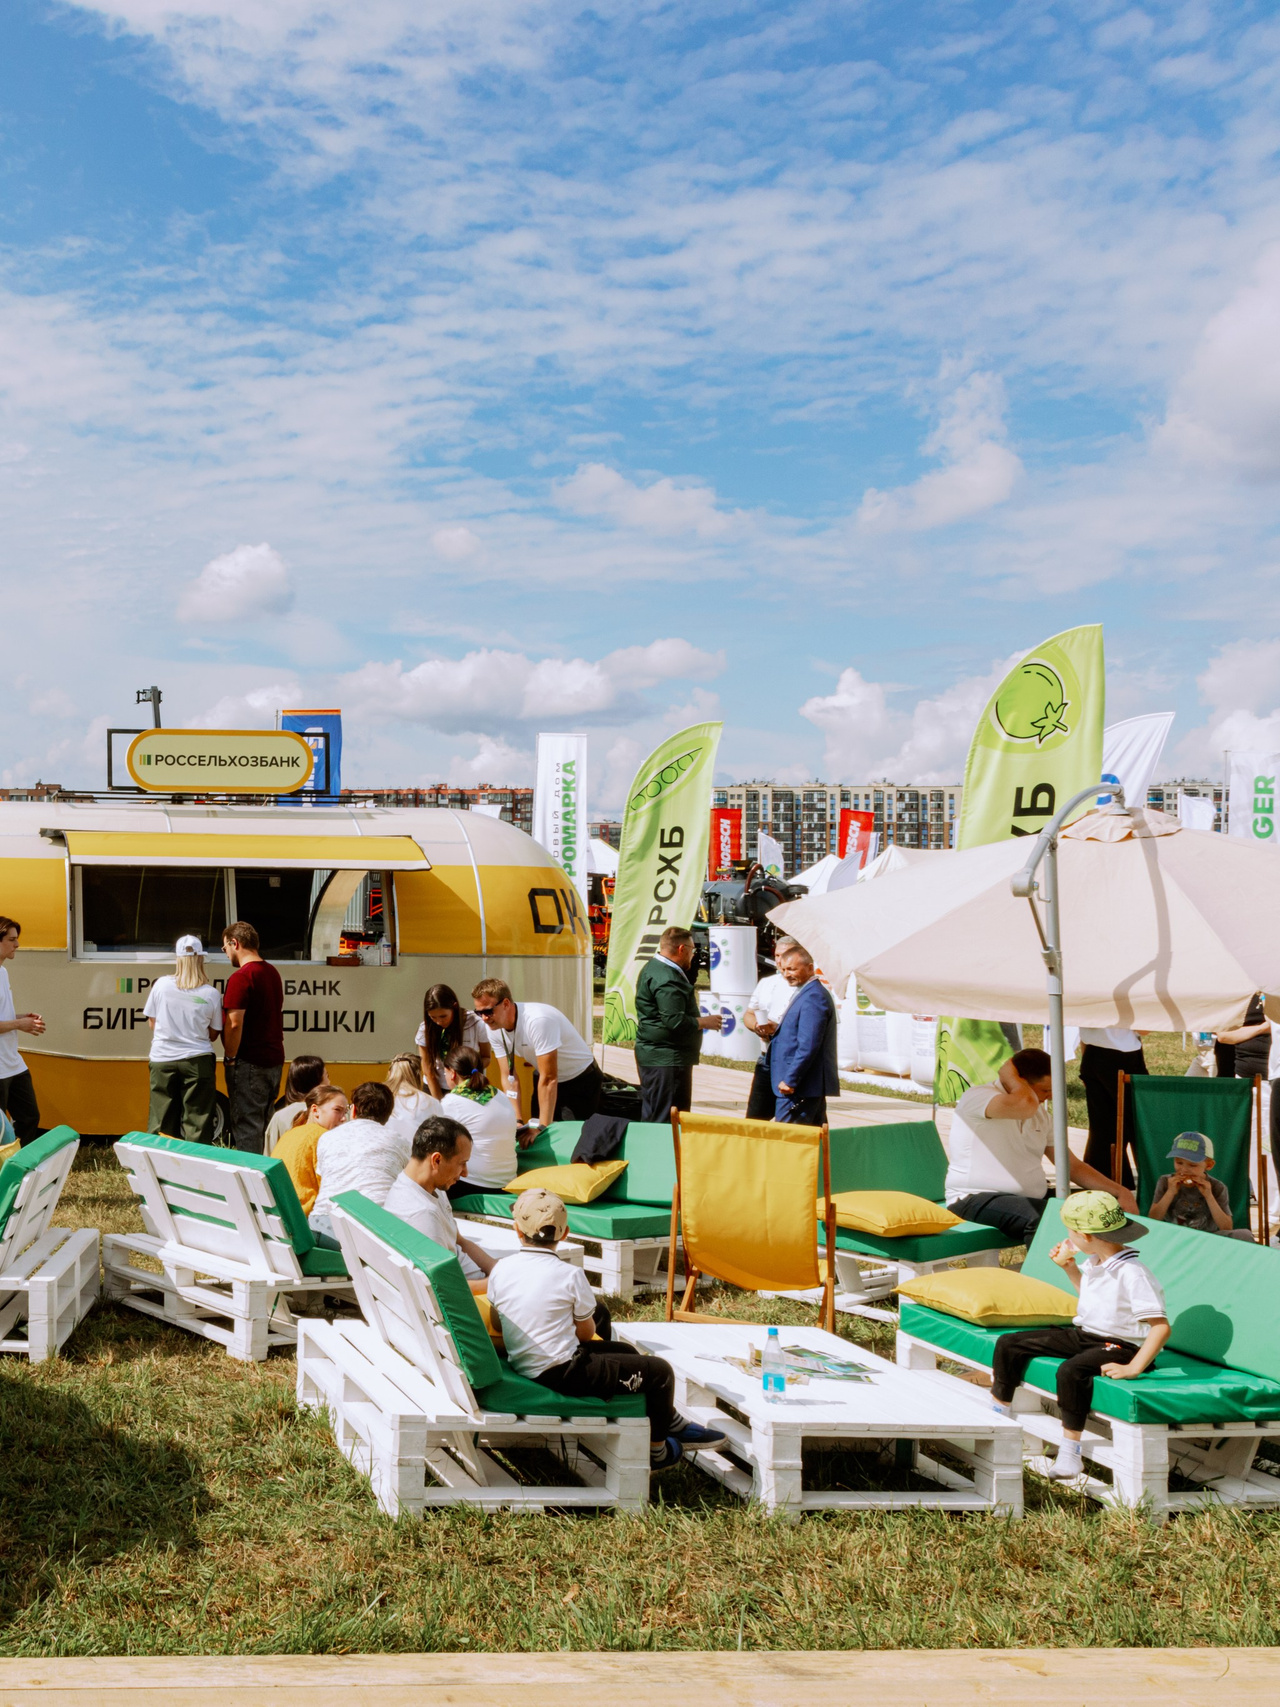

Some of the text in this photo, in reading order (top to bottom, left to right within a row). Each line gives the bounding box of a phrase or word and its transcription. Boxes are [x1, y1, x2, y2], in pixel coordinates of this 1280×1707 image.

[155, 754, 301, 768] РОССЕЛЬХОЗБАНК
[561, 760, 577, 877] РОМАРКА
[719, 818, 731, 869] HORSCH
[846, 820, 861, 855] RSCH
[647, 825, 684, 926] РСХБ
